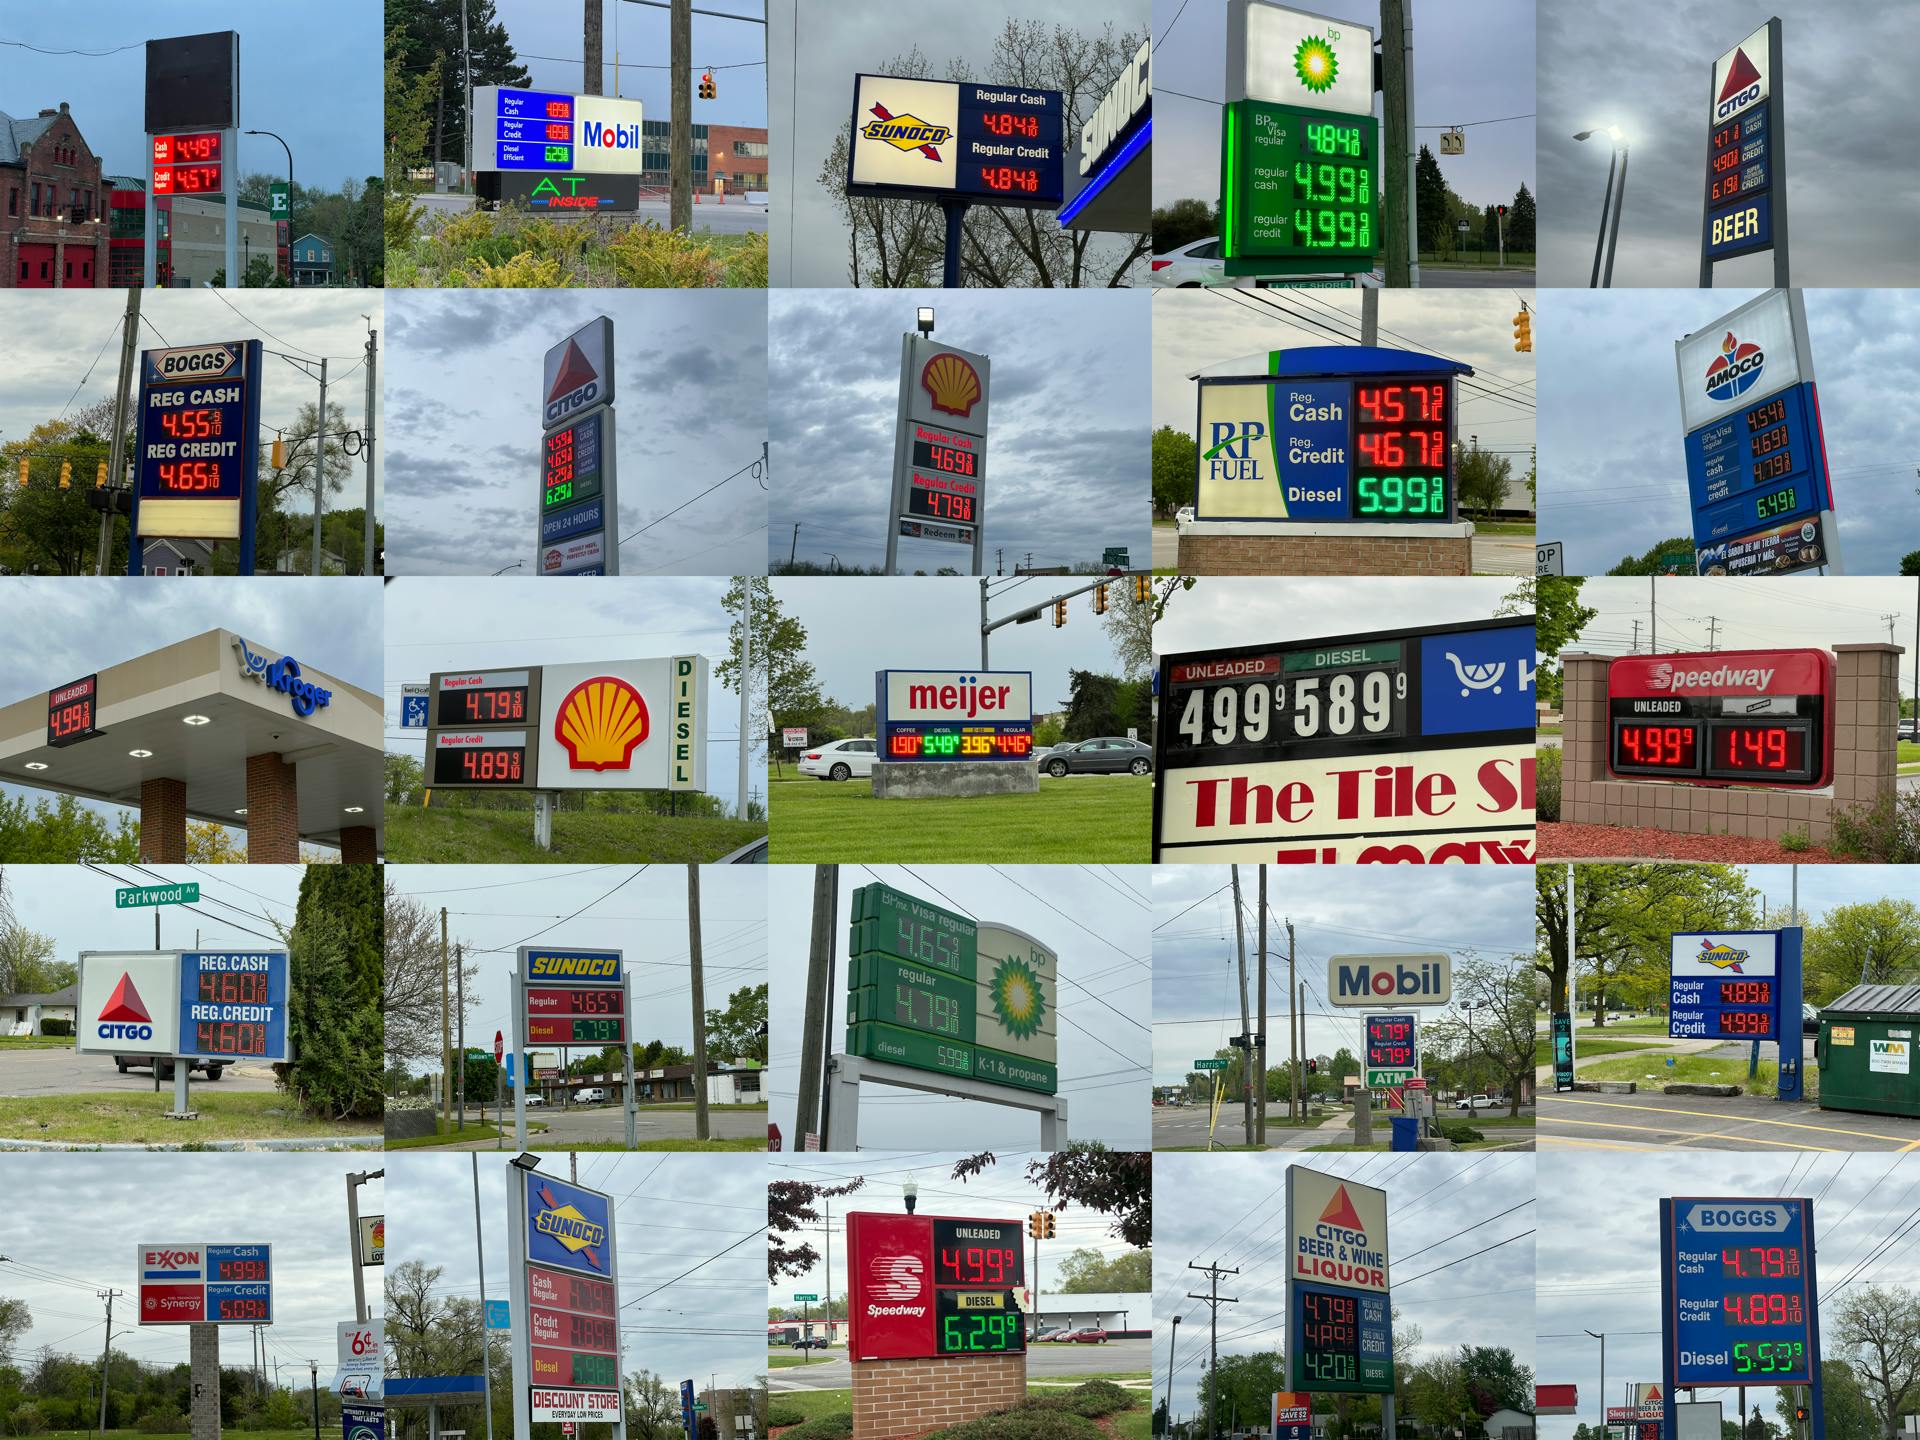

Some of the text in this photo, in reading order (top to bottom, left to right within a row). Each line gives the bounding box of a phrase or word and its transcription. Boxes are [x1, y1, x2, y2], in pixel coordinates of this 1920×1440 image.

[1328, 26, 1341, 41] bp
[976, 90, 1046, 106] Regular Cash
[1718, 84, 1760, 118] CITGO
[505, 107, 518, 115] Cash
[504, 121, 523, 129] Regular
[1268, 126, 1286, 137] Visa
[1745, 120, 1762, 134] CASH
[504, 131, 521, 139] Credit
[584, 121, 639, 149] Mobil
[868, 124, 948, 142] SUNOCO
[155, 142, 167, 151] Cash
[1255, 136, 1284, 146] regular
[972, 142, 1049, 158] Regular Credit
[1742, 144, 1765, 162] CREDIT
[155, 172, 170, 181] Credit
[1254, 168, 1288, 178] regular
[1254, 181, 1277, 190] cash
[1742, 174, 1765, 191] CREDIT
[272, 194, 287, 210] E
[549, 196, 598, 207] INSIDE
[1254, 215, 1288, 226] regular
[1712, 208, 1759, 246] BEER
[1254, 228, 1281, 238] credit
[164, 350, 226, 373] BOGGS
[1705, 352, 1764, 392] AMOCO
[150, 387, 240, 407] REG CASH
[547, 382, 597, 420] CITGO
[1290, 393, 1316, 403] Reg.
[1289, 404, 1343, 422] Cash
[916, 426, 972, 449] Regular Cash
[1718, 427, 1732, 437] Visa
[1209, 422, 1265, 460] RP
[1289, 437, 1314, 448] Reg.
[147, 442, 237, 459] REG CREDIT
[1289, 448, 1344, 464] Credit
[1705, 455, 1725, 467] regular
[1209, 460, 1264, 480] FUEL
[1706, 464, 1723, 477] cash
[913, 473, 975, 494] Regular Credit
[1707, 479, 1727, 490] regular
[1288, 487, 1342, 502] Diesel
[1708, 487, 1729, 501] credit
[543, 508, 599, 535] OPEN 24 HOURS
[924, 528, 956, 539] Redeem
[1712, 524, 1728, 536] diesel
[1728, 546, 1744, 557] SABOR
[1745, 544, 1752, 553] DE
[1762, 535, 1780, 548] TIERRA
[1315, 649, 1371, 666] DIESEL
[1186, 661, 1265, 679] UNLEADED
[445, 678, 466, 688] Regular
[1646, 663, 1774, 692] Speedway
[55, 683, 88, 704] UNLEADED
[267, 656, 332, 717] Kroger
[910, 676, 1010, 718] meijer
[1634, 701, 1681, 713] UNLEADED
[676, 660, 692, 782] DIESEL
[441, 735, 483, 746] Regular Credit
[1730, 730, 1786, 767] 1.49
[1186, 765, 1457, 828] The Tile
[119, 886, 195, 906] Parkwood Av
[911, 903, 975, 937] Visa regular
[1030, 947, 1046, 967] bp
[1701, 952, 1745, 961] SUNOCO
[532, 957, 617, 976] SUNOCO
[899, 968, 936, 986] regular
[1338, 963, 1440, 996] Mobil
[1673, 981, 1704, 991] Regular
[529, 997, 558, 1008] Regular
[1673, 992, 1700, 1004] Cash
[1672, 1011, 1704, 1021] Regular
[98, 1024, 153, 1040] CITGO
[530, 1026, 554, 1035] Diesel
[1672, 1022, 1706, 1034] Credit
[878, 1041, 906, 1055] diesel
[1873, 1042, 1904, 1053] WM
[979, 1057, 1047, 1083] K-1 & propane
[1375, 1072, 1406, 1084] ATM
[1701, 1209, 1777, 1226] BOGGS
[539, 1212, 603, 1245] SUNOCO
[956, 1228, 1000, 1239] UNLEADED
[1316, 1223, 1367, 1247] CITGO
[233, 1247, 258, 1256] Cash
[1299, 1236, 1383, 1268] BEER & WINE
[1679, 1252, 1717, 1263] Regular
[146, 1250, 199, 1269] EXXON
[1297, 1255, 1385, 1287] LIQUOR
[1679, 1264, 1704, 1274] Cash
[533, 1274, 552, 1289] Cash
[234, 1285, 266, 1295] Credit
[533, 1287, 558, 1301] Regular
[161, 1298, 201, 1310] Synergy
[966, 1296, 995, 1307] DIESEL
[1680, 1298, 1718, 1311] Regular
[867, 1304, 925, 1318] Speedway
[1364, 1309, 1382, 1322] CASH
[1680, 1311, 1710, 1321] Credit
[534, 1313, 558, 1328] Credit
[534, 1327, 559, 1340] Regular
[1362, 1340, 1385, 1352] CREDIT
[1680, 1351, 1728, 1366] Diesel
[536, 1360, 558, 1373] Diesel
[1366, 1369, 1384, 1378] DIESEL
[534, 1391, 618, 1409] DISCOUNT STORE
